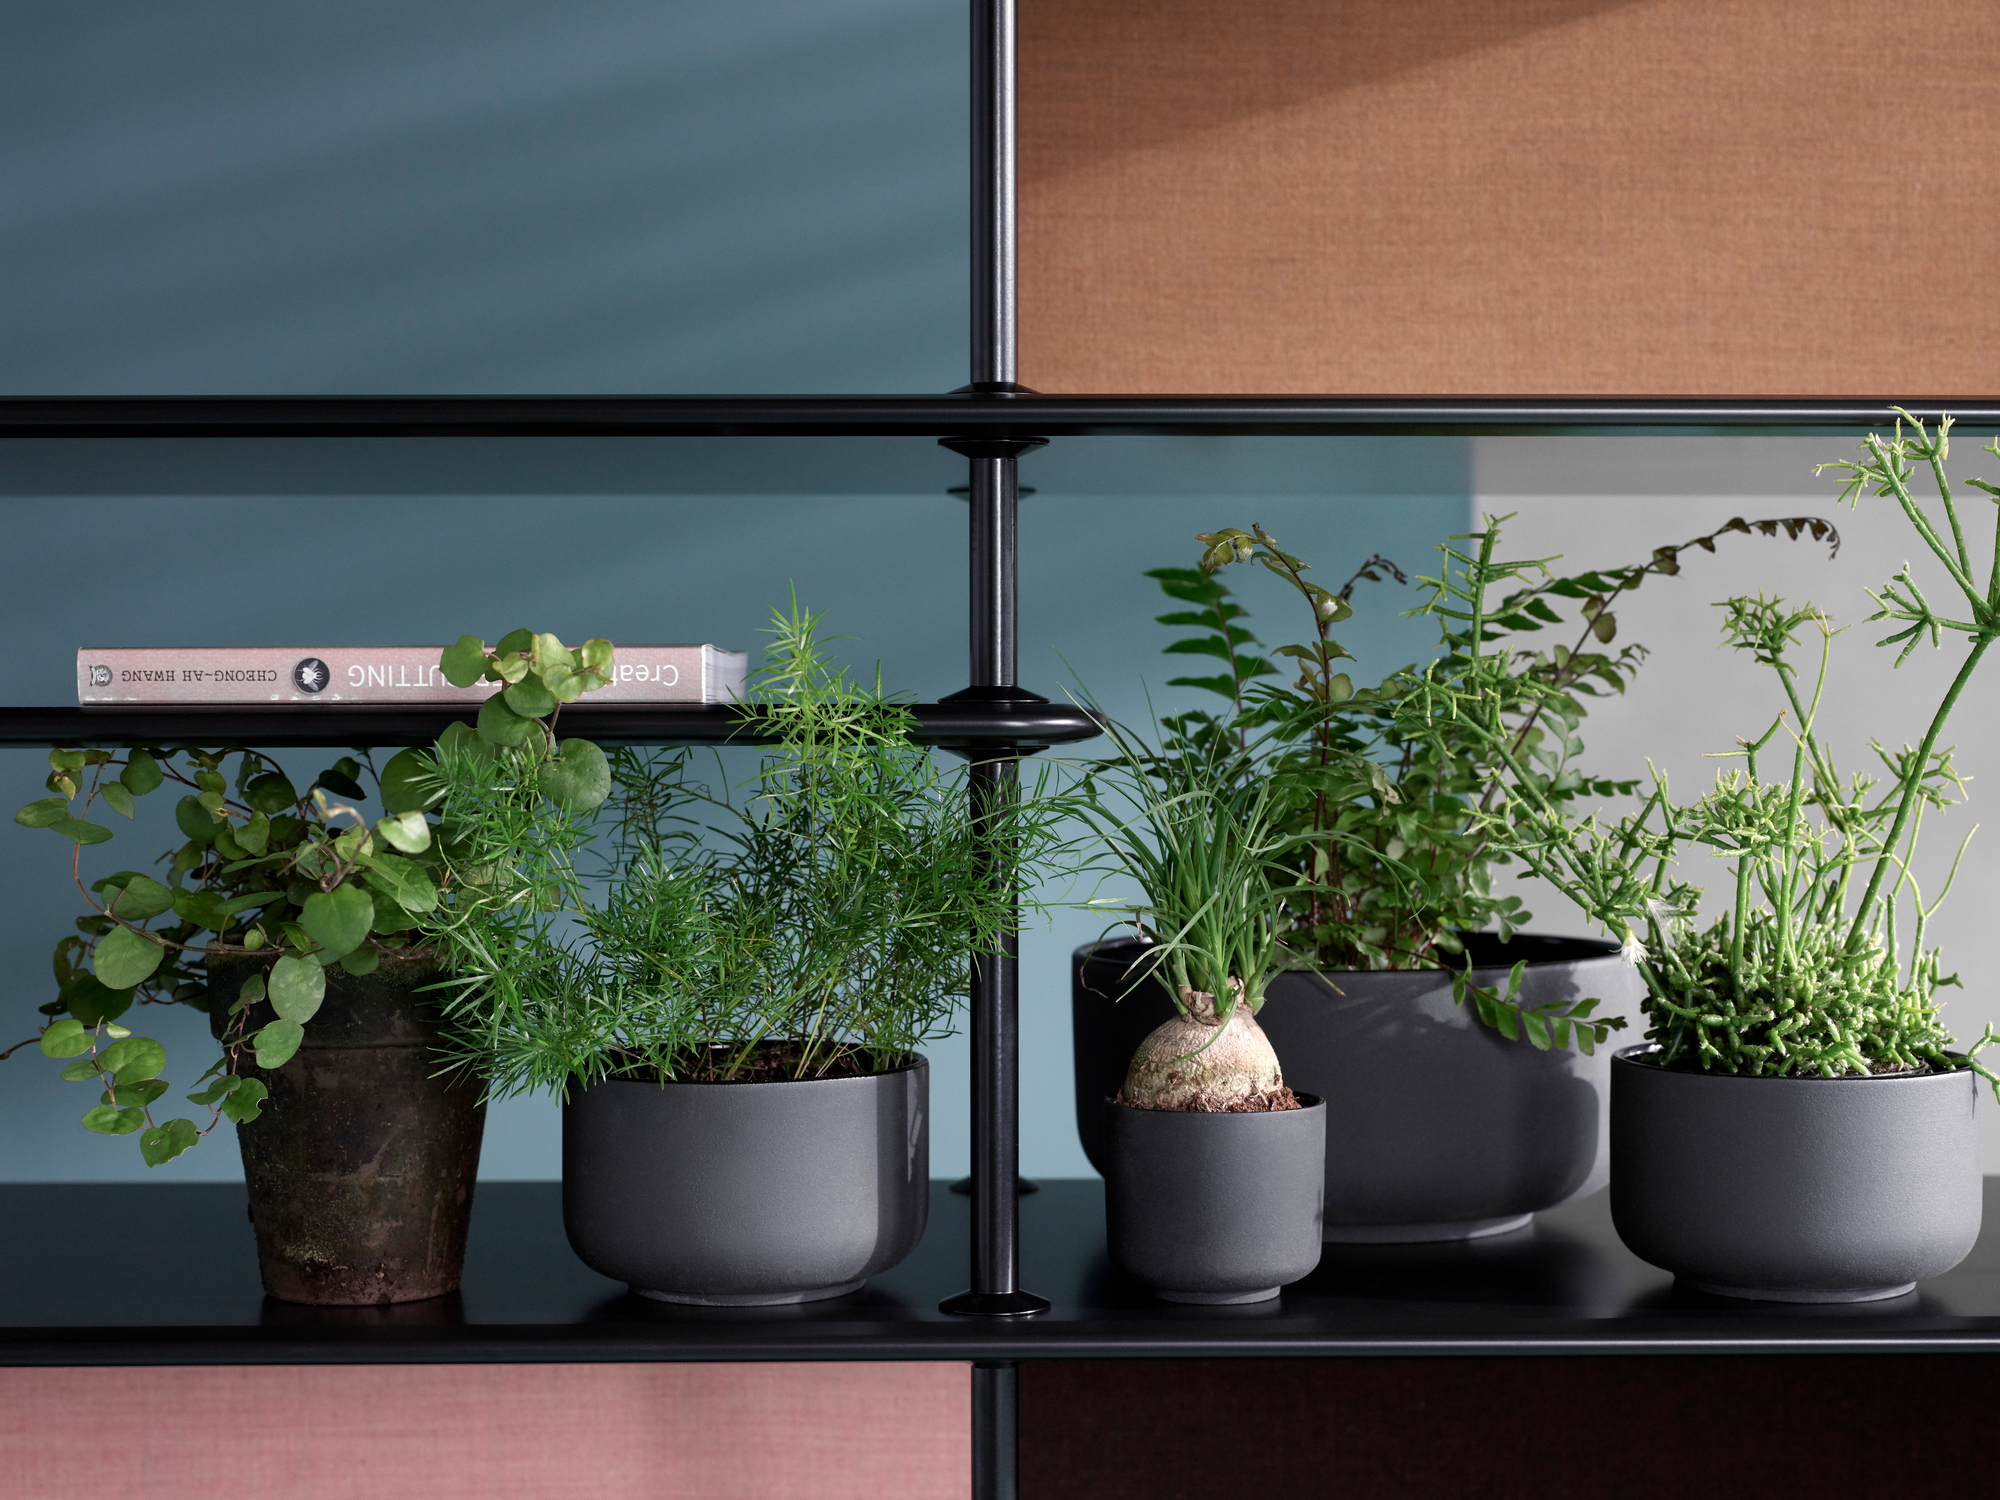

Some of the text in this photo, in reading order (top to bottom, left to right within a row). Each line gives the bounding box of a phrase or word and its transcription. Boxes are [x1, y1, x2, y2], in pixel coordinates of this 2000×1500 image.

[121, 669, 176, 682] HWANG
[347, 664, 456, 687] UTTING
[604, 664, 679, 687] Creat
